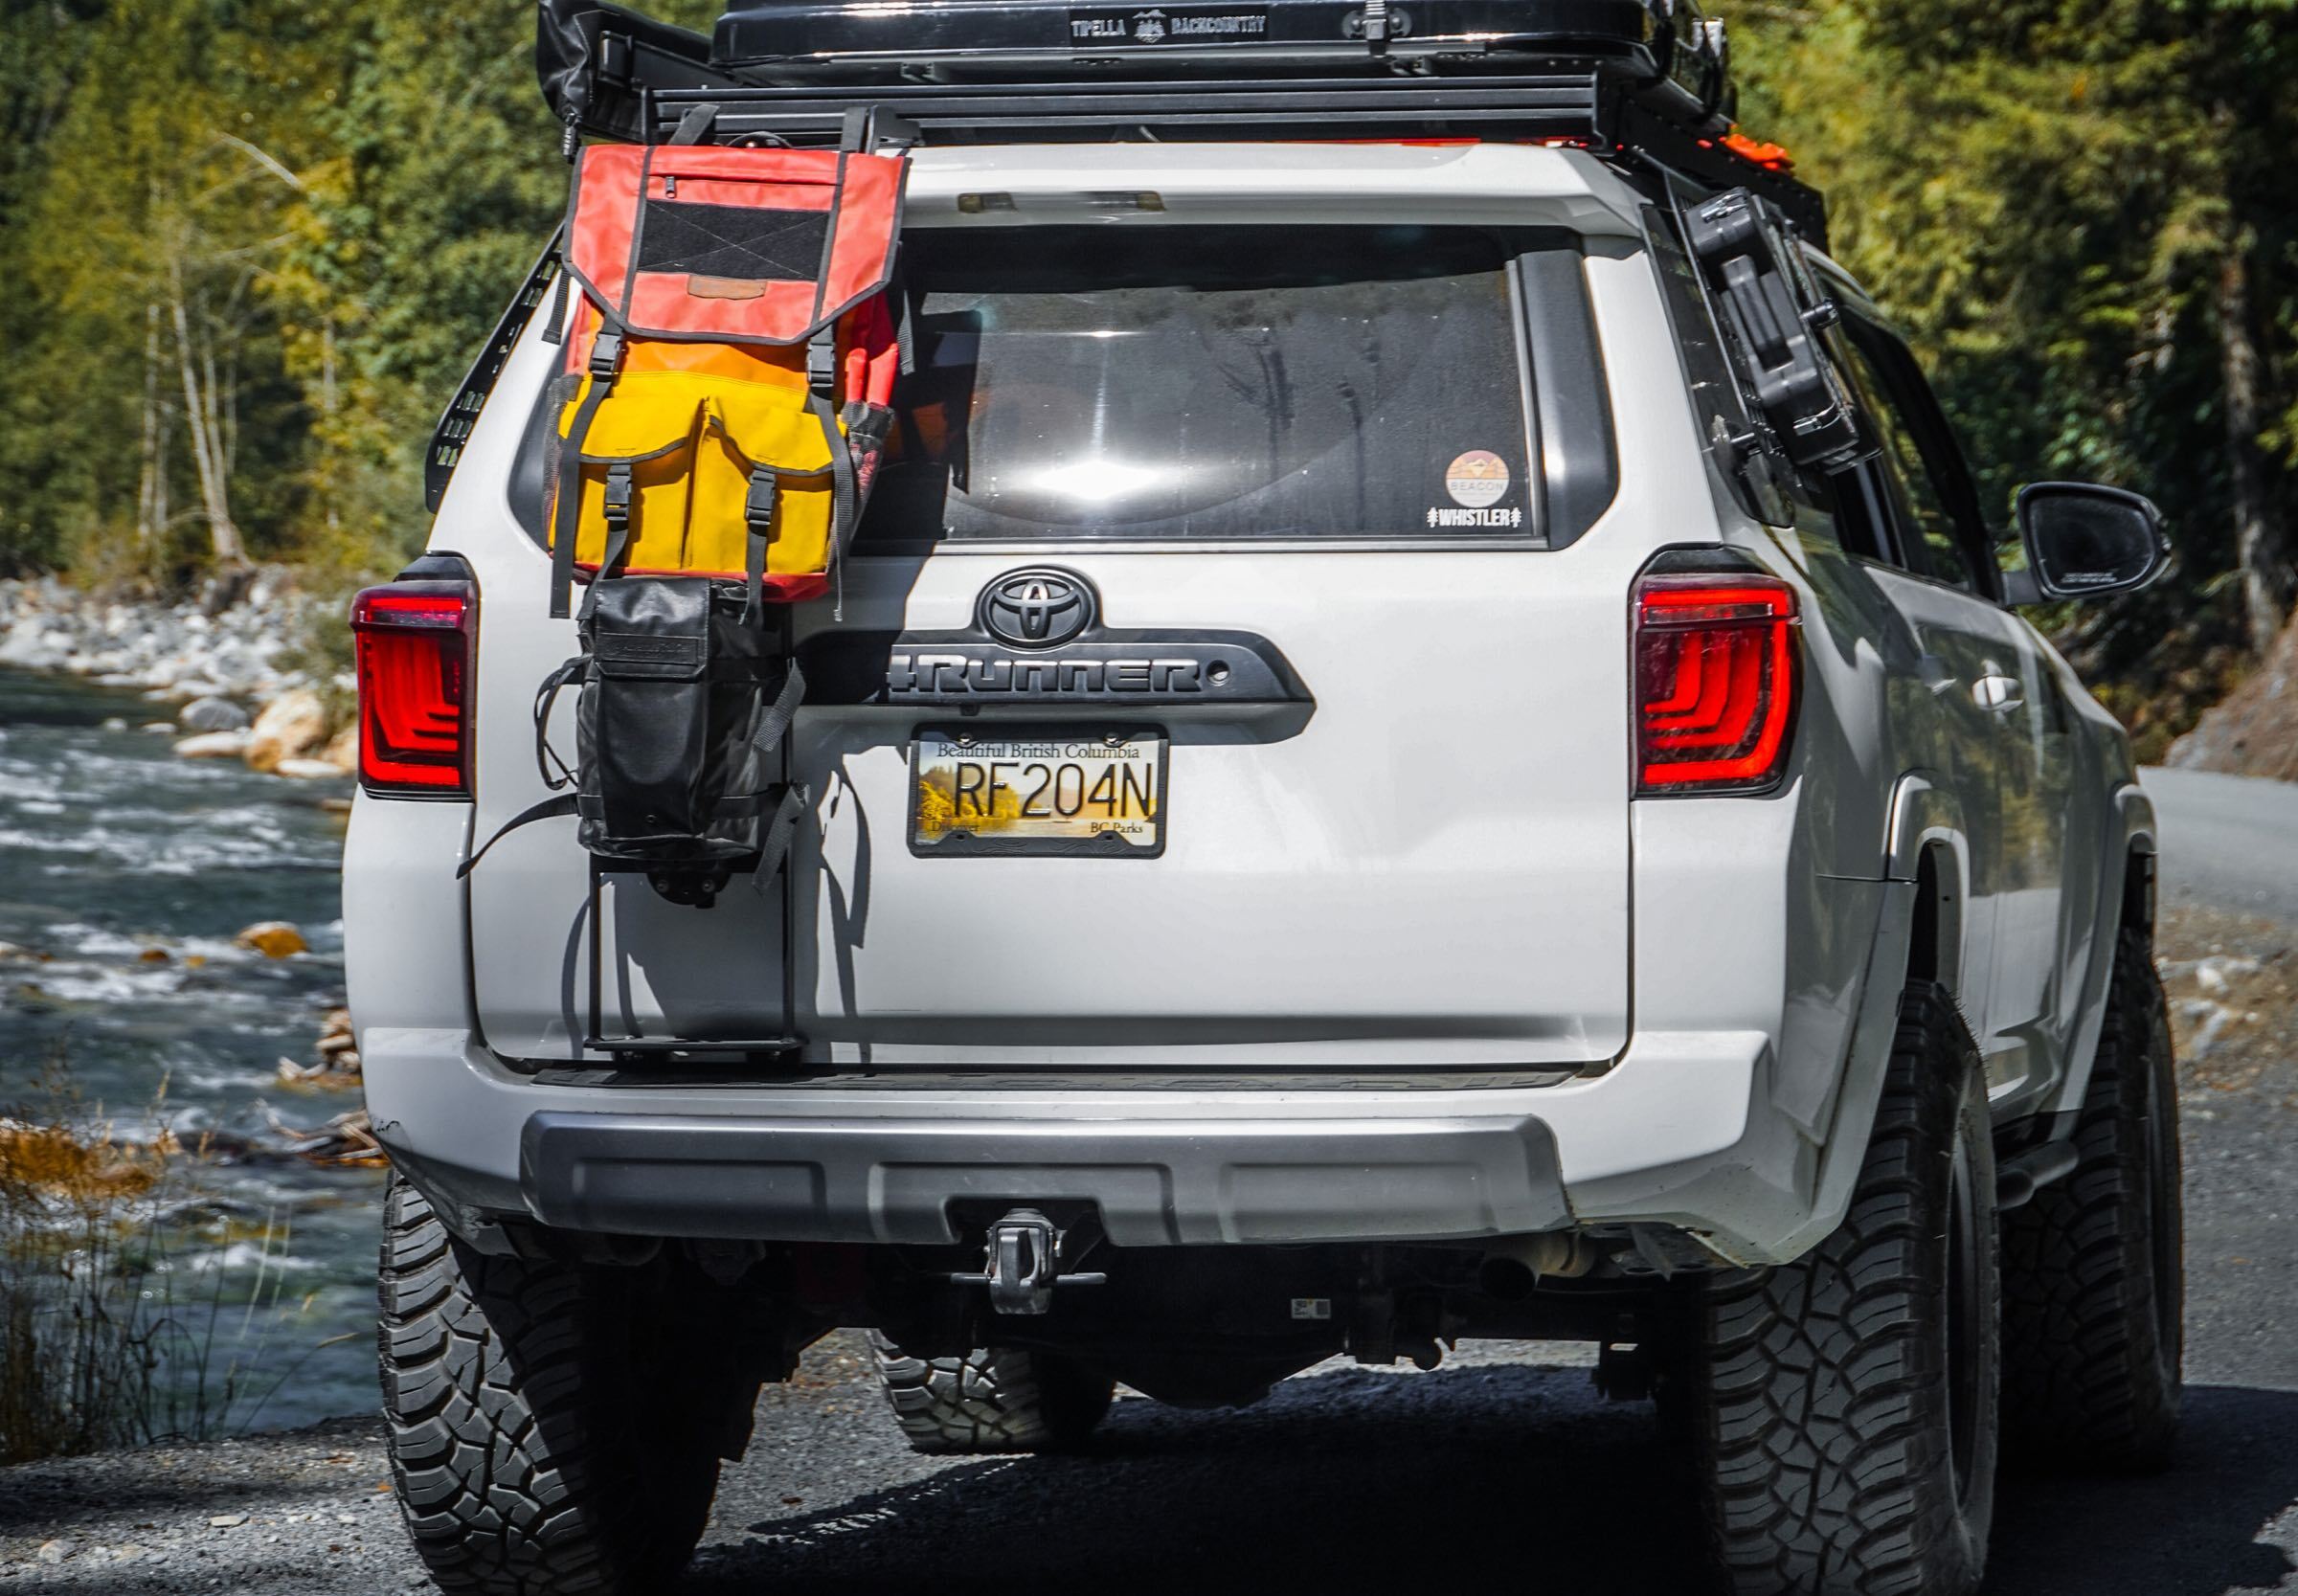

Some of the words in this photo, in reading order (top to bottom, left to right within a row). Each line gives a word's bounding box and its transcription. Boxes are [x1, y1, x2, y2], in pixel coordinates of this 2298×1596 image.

[1070, 19, 1126, 37] TIPELLA
[1438, 508, 1511, 527] WHISTLER
[937, 743, 1005, 758] Beautiful
[1011, 743, 1060, 758] British
[1065, 743, 1139, 758] Columbia
[955, 762, 1152, 818] RF204N
[1091, 822, 1109, 833] BC
[1113, 822, 1143, 833] Parks
